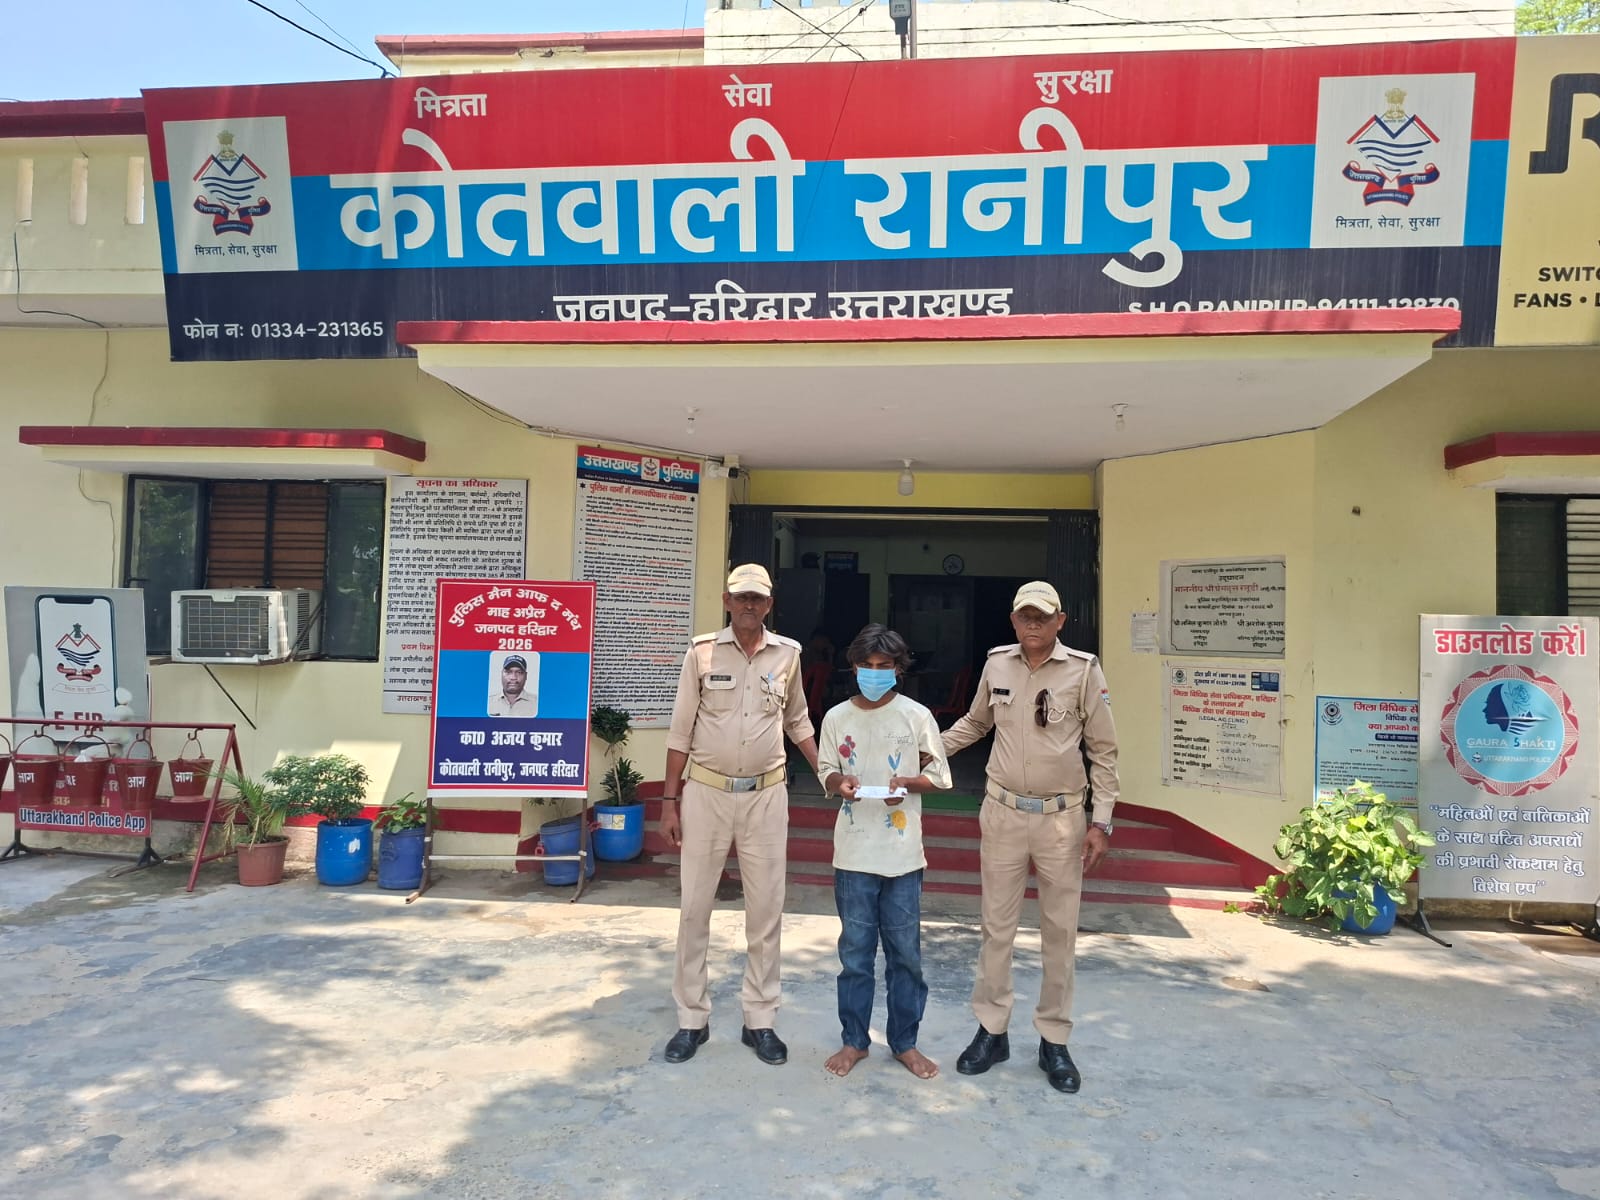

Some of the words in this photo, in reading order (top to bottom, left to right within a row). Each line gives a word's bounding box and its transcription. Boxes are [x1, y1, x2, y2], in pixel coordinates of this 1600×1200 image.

[722, 73, 772, 109] सेवा
[1034, 68, 1113, 103] सुरक्षा
[414, 87, 487, 119] मित्रता
[330, 116, 805, 260] कोतवाली
[844, 106, 1268, 288] रानीपुर
[1335, 215, 1373, 230] मित्रता,
[1377, 214, 1404, 229] सेवा,
[1408, 216, 1441, 231] सुरक्षा
[194, 244, 225, 257] मित्रता,
[227, 243, 249, 256] सेवा,
[252, 244, 277, 258] सुरक्षा
[552, 279, 816, 322] जनपद-हरिद्वार
[828, 288, 1013, 320] उत्तराखण्ड
[1513, 293, 1572, 309] FANS
[182, 318, 219, 339] फोन
[251, 321, 384, 339] 01334-231365
[583, 453, 640, 473] उत्तराखण्ड
[662, 462, 694, 482] पुलिस
[448, 593, 485, 627] पुलिस
[486, 586, 512, 601] मैन
[515, 588, 549, 604] आफ
[550, 598, 563, 611] द
[562, 608, 583, 631] मंथ
[487, 606, 510, 619] माह
[513, 605, 546, 620] अप्रैल
[474, 623, 515, 635] जनपद
[518, 622, 558, 637] हरिद्वार
[1434, 624, 1535, 655] डाउनलोड
[1540, 624, 1587, 656] करें।
[498, 638, 533, 650] 2026
[1354, 702, 1377, 711] जिला
[1379, 702, 1407, 712] विधिक
[491, 730, 526, 746] अजय
[529, 731, 563, 750] कुमार
[1466, 738, 1508, 748] GAURA
[1513, 736, 1557, 749] SHAKTI
[174, 771, 194, 783] आग
[439, 758, 481, 777] कोतवाली
[483, 759, 516, 781] रानीपुर,
[519, 761, 549, 777] जनपद
[551, 760, 580, 778] हरिद्वार
[128, 775, 146, 788] आग
[20, 808, 85, 827] Uttarakhand
[88, 810, 121, 829] Police
[124, 814, 146, 832] App
[1497, 805, 1519, 823] एवं
[1521, 806, 1591, 824] बालिकाओं
[1436, 827, 1451, 844] के
[1454, 830, 1484, 845] साथ
[1488, 830, 1524, 846] घटित
[1528, 831, 1583, 848] अपराधों
[1436, 852, 1454, 868] की
[1458, 853, 1500, 870] प्रभावी
[1503, 855, 1558, 872] रोकथाम
[1563, 858, 1585, 877] हेतु
[1472, 878, 1510, 895] विशेष
